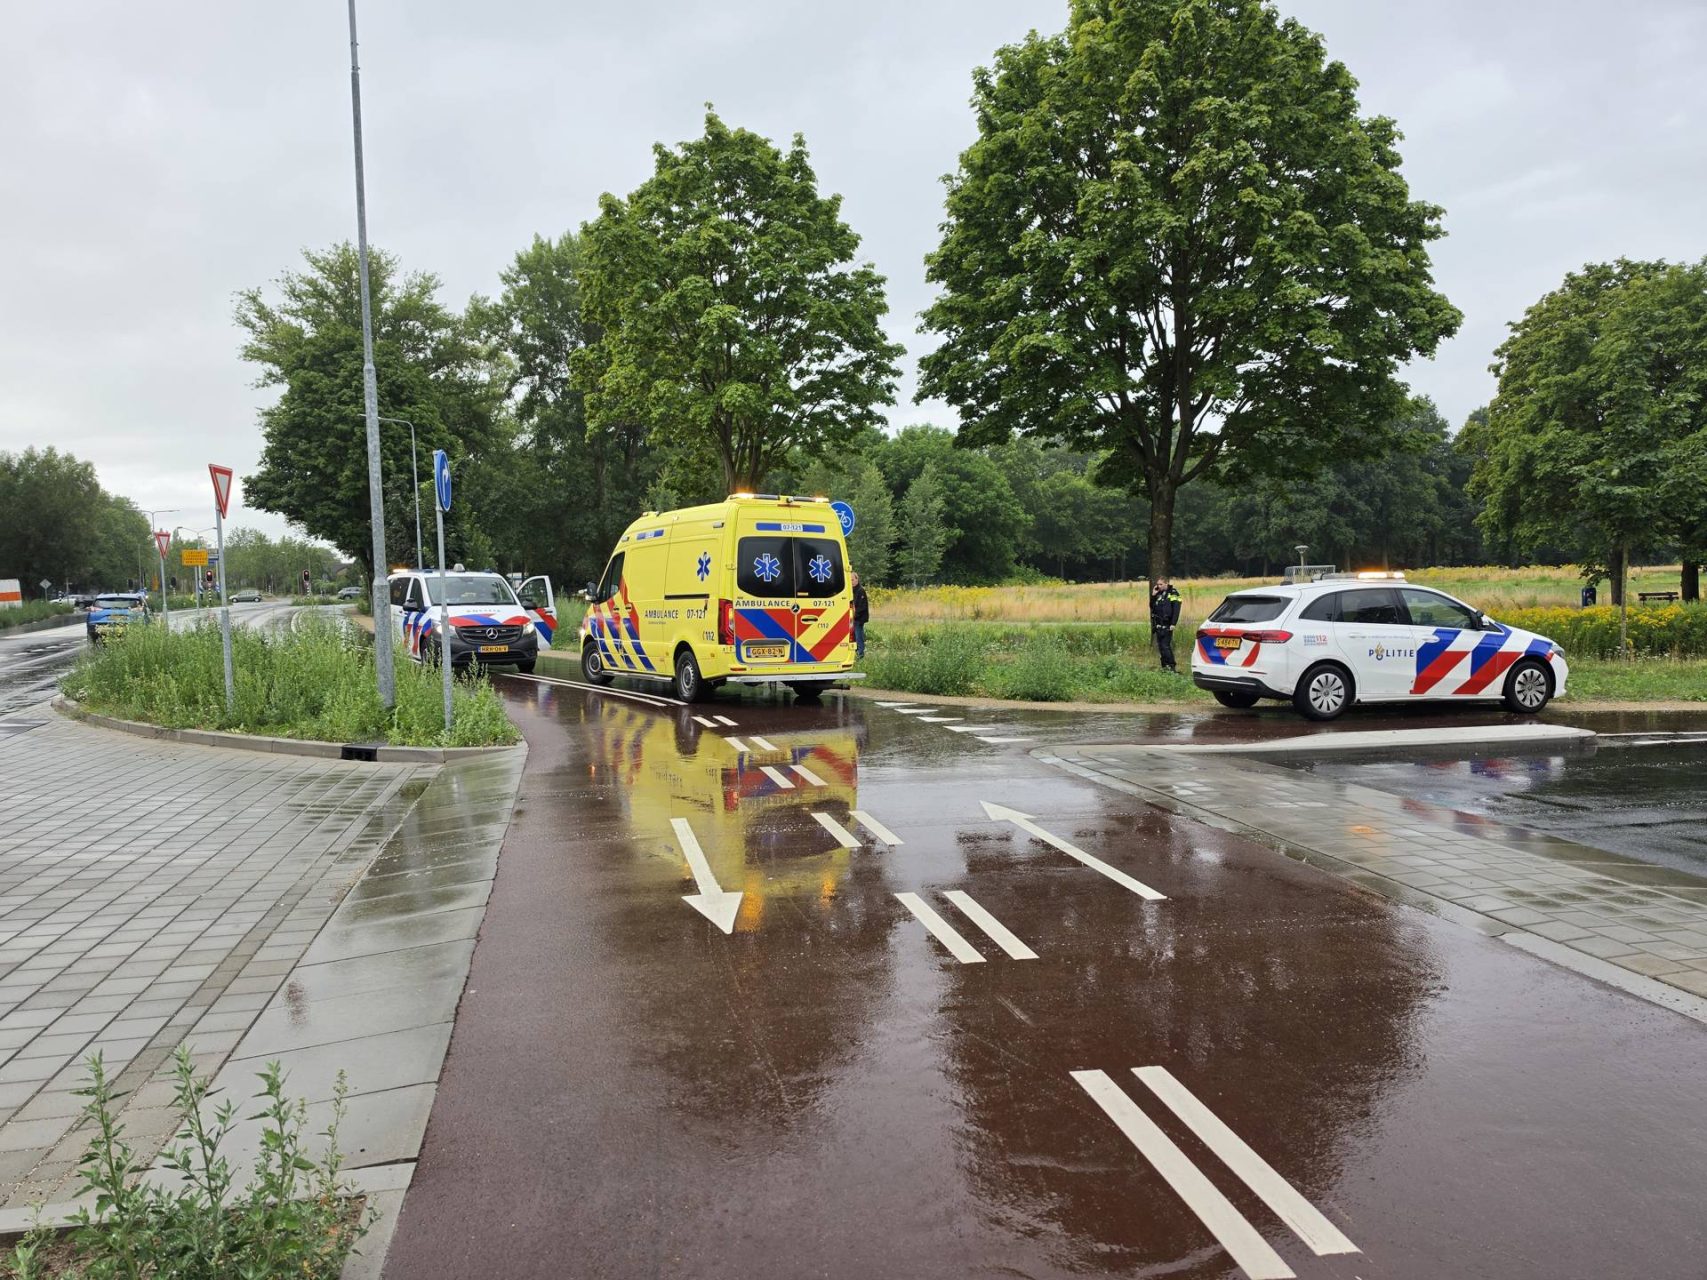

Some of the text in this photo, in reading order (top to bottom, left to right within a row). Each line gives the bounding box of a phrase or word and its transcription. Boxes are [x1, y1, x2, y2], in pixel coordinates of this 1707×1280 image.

[645, 609, 706, 619] AMBULANCE 07-121
[751, 647, 783, 656] GGX-82-N
[1368, 648, 1415, 661] POLITIE
